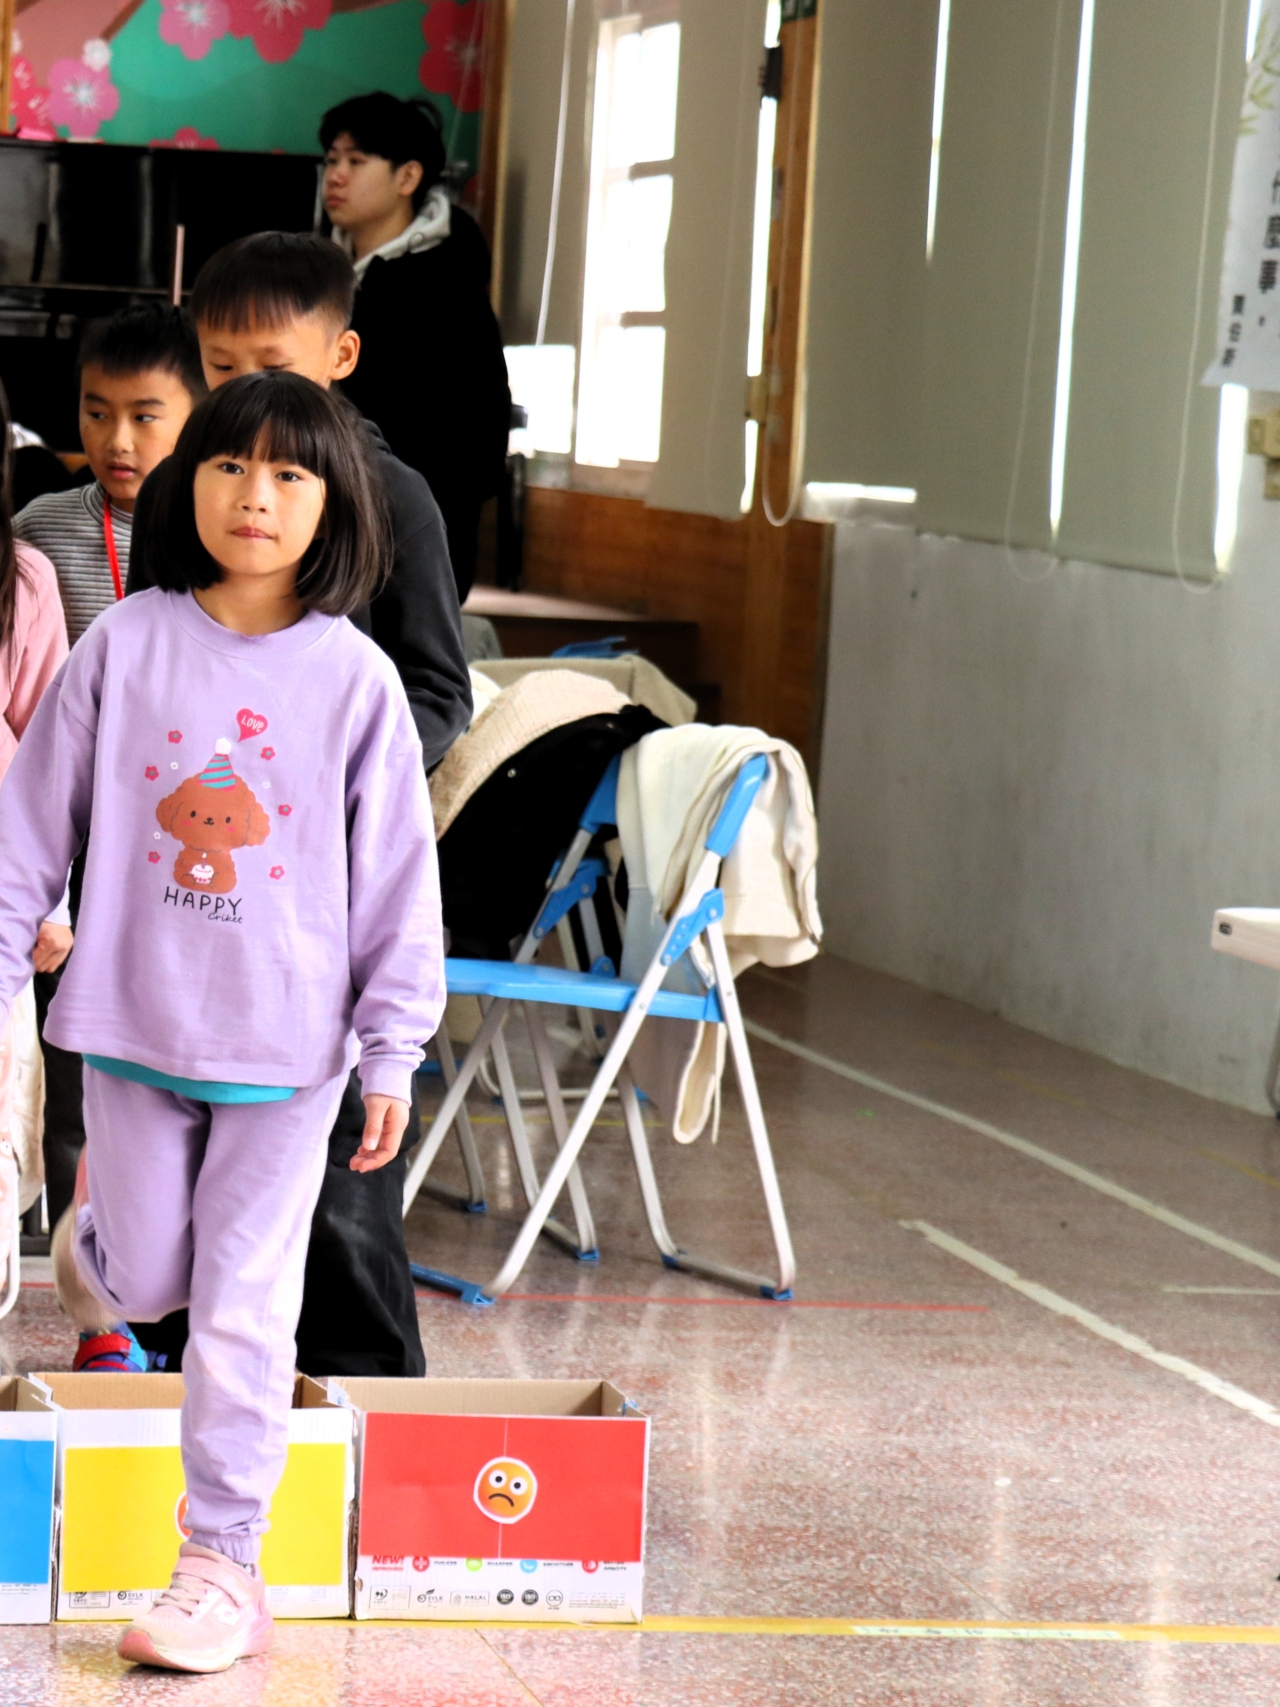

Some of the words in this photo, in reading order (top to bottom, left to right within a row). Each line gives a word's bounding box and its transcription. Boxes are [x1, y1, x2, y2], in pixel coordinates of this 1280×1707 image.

[163, 885, 242, 916] HAPPY
[207, 912, 243, 924] Criket
[372, 1555, 404, 1565] NEW!
